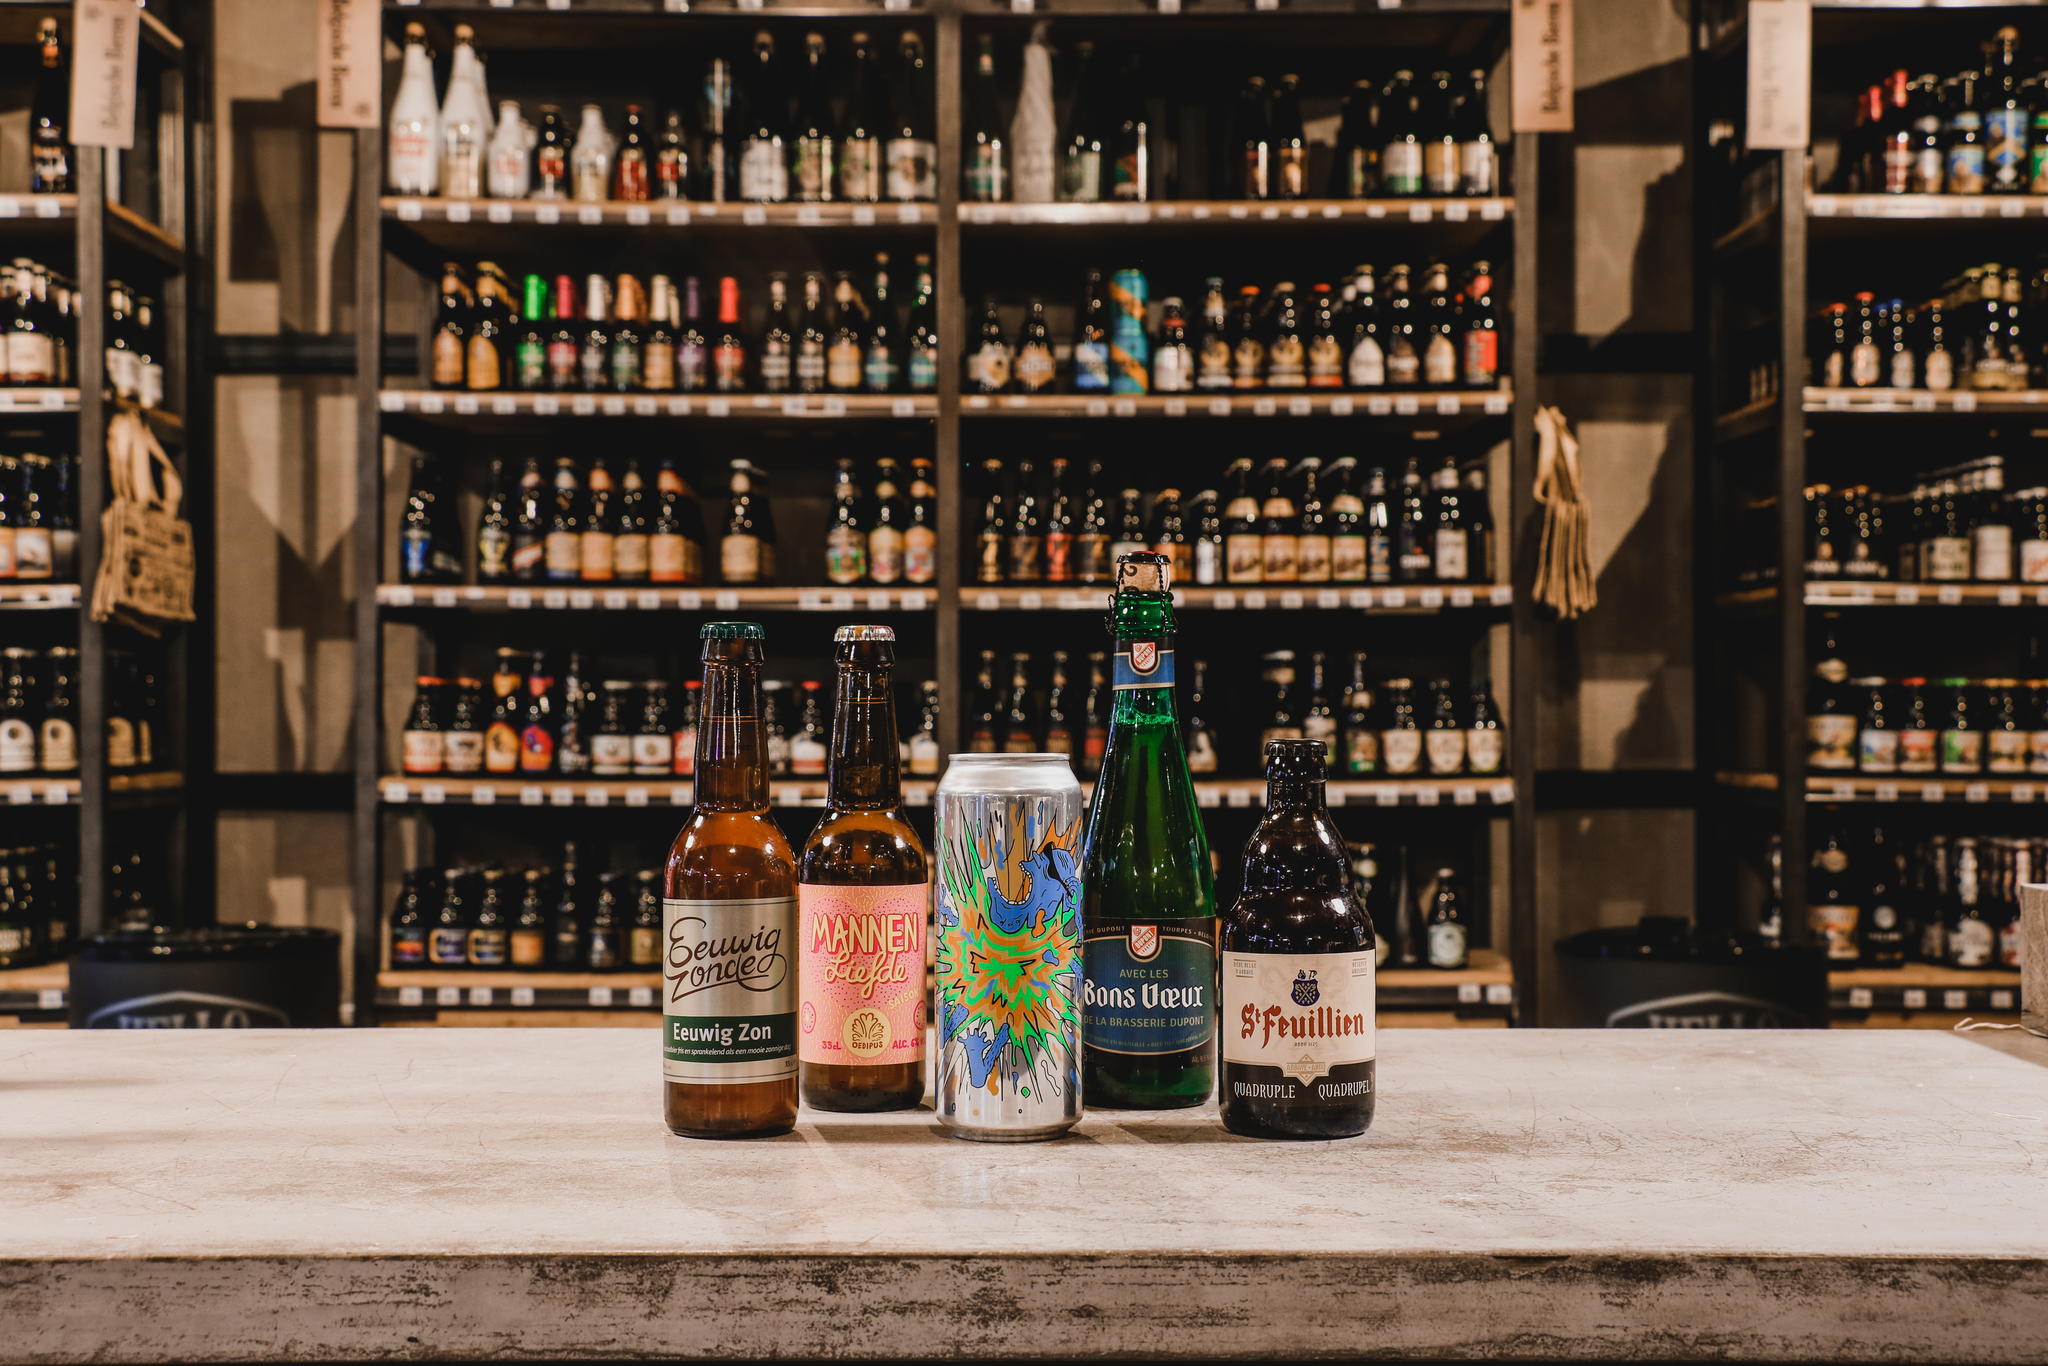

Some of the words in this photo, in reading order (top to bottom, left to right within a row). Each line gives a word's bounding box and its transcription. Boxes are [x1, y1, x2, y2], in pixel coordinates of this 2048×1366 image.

[811, 912, 919, 954] MANNEN
[1096, 926, 1125, 934] DUPONT
[1134, 929, 1154, 949] DUPONT
[1162, 926, 1192, 935] TOURPES
[669, 917, 785, 973] Eeuwig
[664, 954, 772, 1003] Zonde
[824, 950, 909, 999] Liefde
[1120, 969, 1146, 978] AVEC
[1150, 969, 1169, 978] LES
[888, 988, 919, 1010] SAISON
[1084, 979, 1136, 1009] Bons
[1084, 1015, 1093, 1024] DE
[1096, 1017, 1107, 1026] LA
[1109, 1017, 1166, 1027] BRASSERIE
[1170, 1016, 1204, 1027] DUPONT
[1241, 1002, 1261, 1039] St
[1261, 1004, 1364, 1049] Feuillien
[673, 1022, 733, 1046] Eeuwig
[738, 1023, 771, 1041] Zon
[691, 1048, 724, 1056] sprankelend
[852, 1041, 883, 1050] OEDIPUS
[892, 1040, 909, 1049] ALC.
[1234, 1081, 1296, 1099] QUADRUPLE
[1318, 1080, 1370, 1100] QUADRUPEL
